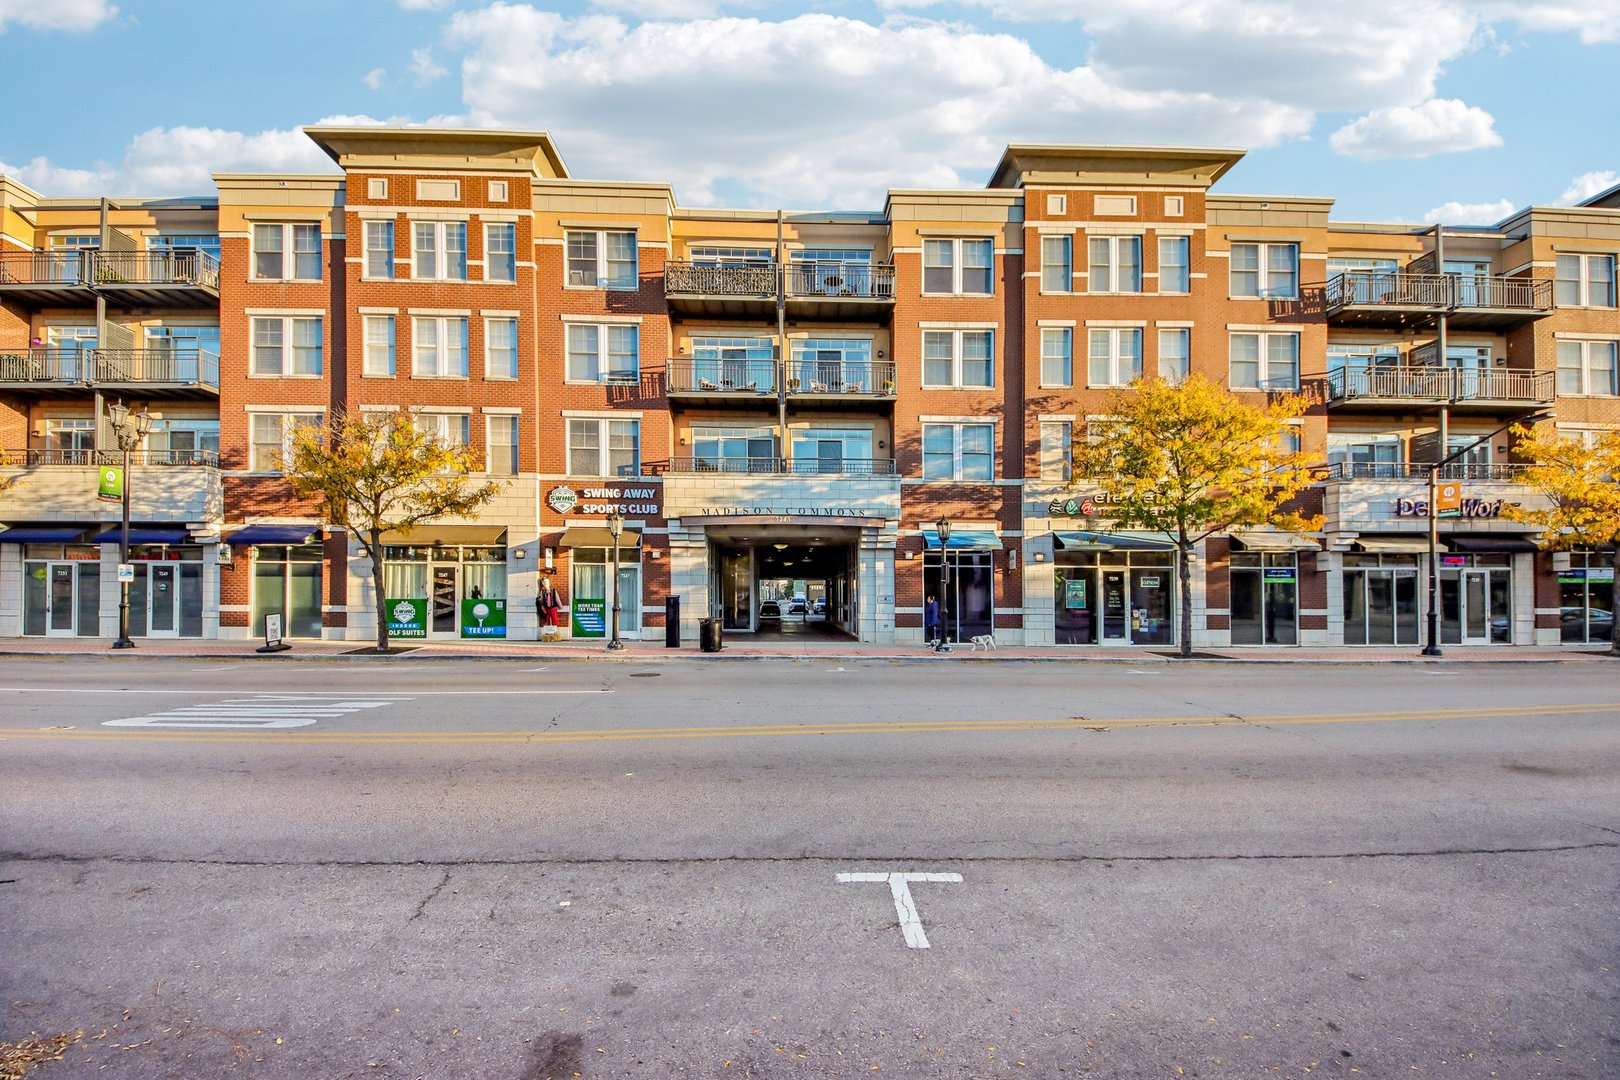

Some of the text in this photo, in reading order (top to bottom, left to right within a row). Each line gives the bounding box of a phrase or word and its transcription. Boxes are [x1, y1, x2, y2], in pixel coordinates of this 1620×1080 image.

[584, 488, 656, 498] SWING AWAY
[583, 504, 659, 514] SPORTS CLUB
[702, 507, 865, 517] MADISON COMMONS
[101, 695, 417, 728] ONLY
